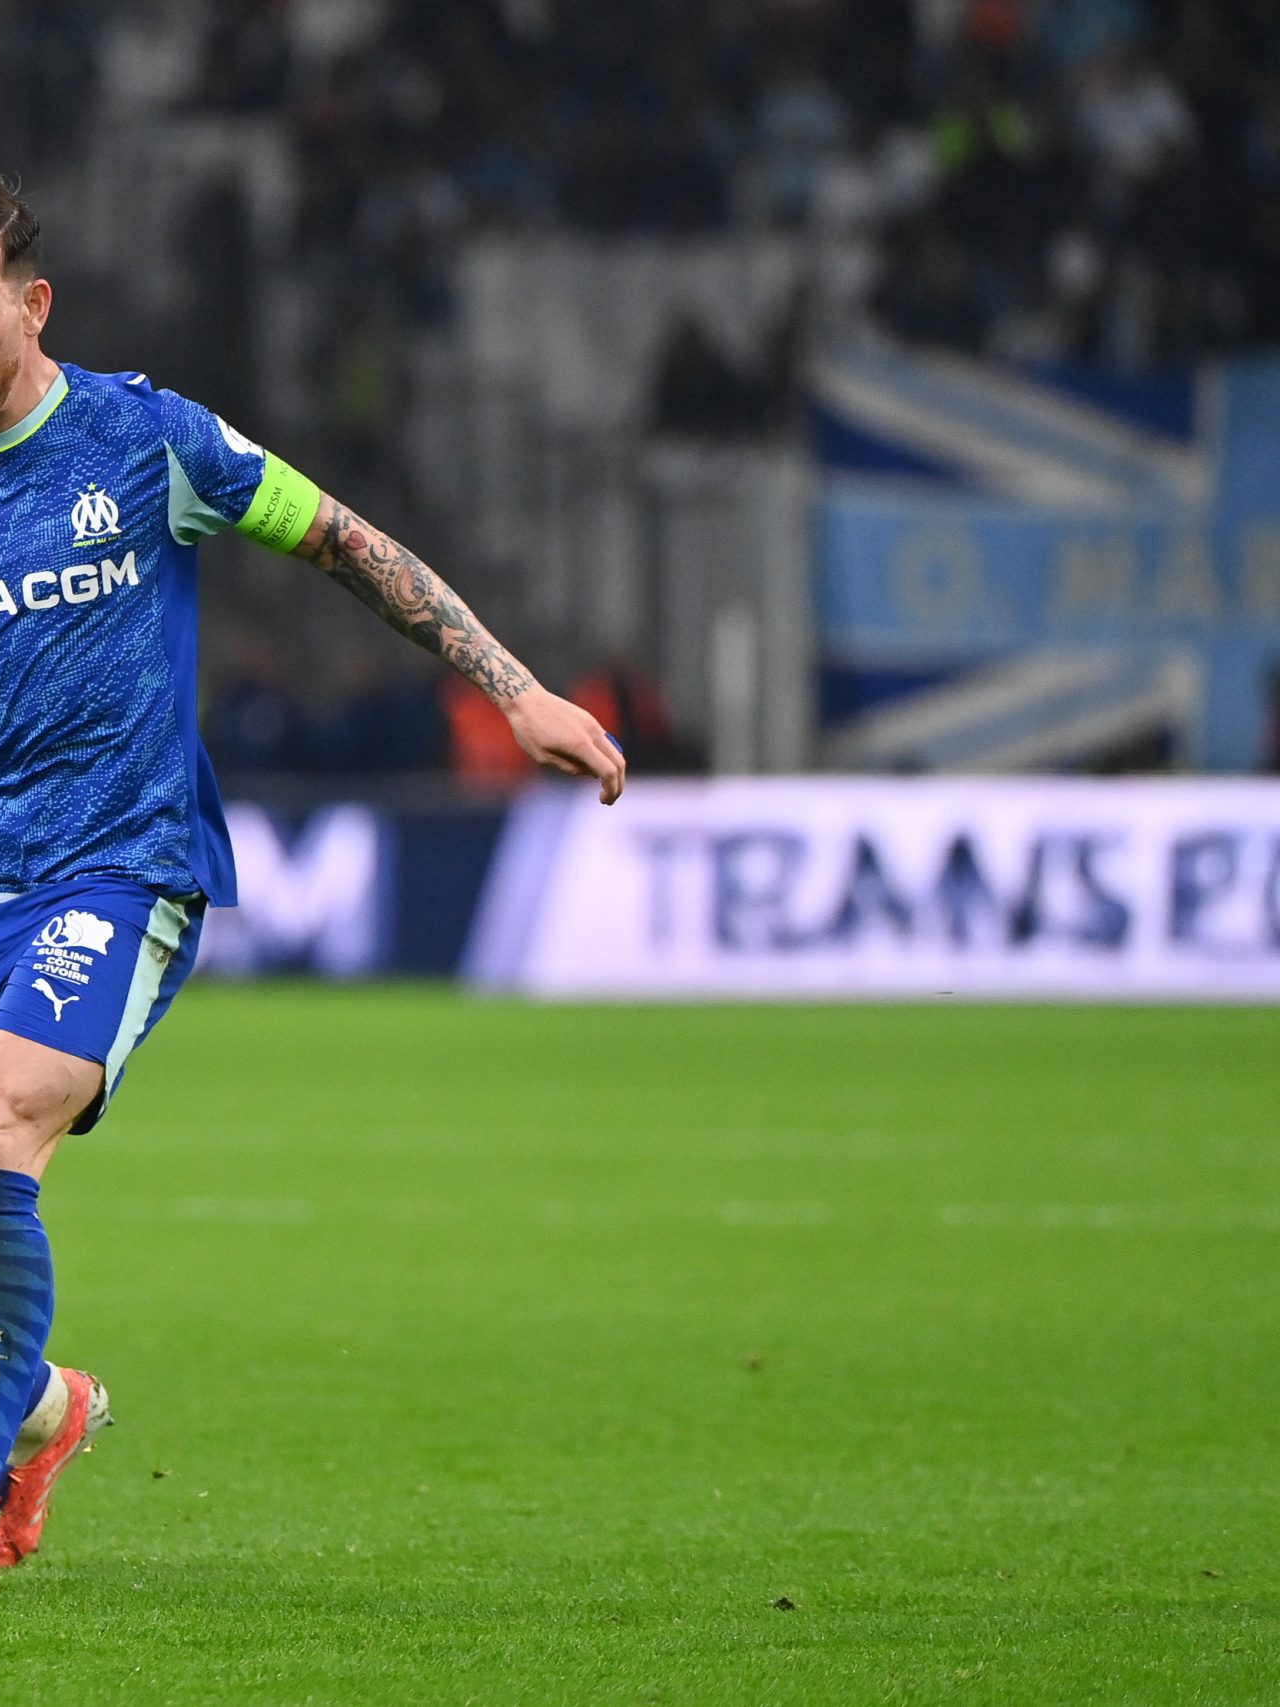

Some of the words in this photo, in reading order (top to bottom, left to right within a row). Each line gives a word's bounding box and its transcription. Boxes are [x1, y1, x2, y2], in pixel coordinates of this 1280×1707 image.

[262, 487, 283, 528] RACISM
[73, 539, 95, 548] DROIT
[22, 551, 140, 610] CGM
[37, 947, 94, 967] SUBLIME
[46, 956, 81, 972] CÔTE
[32, 963, 90, 985] D'IVOIRE
